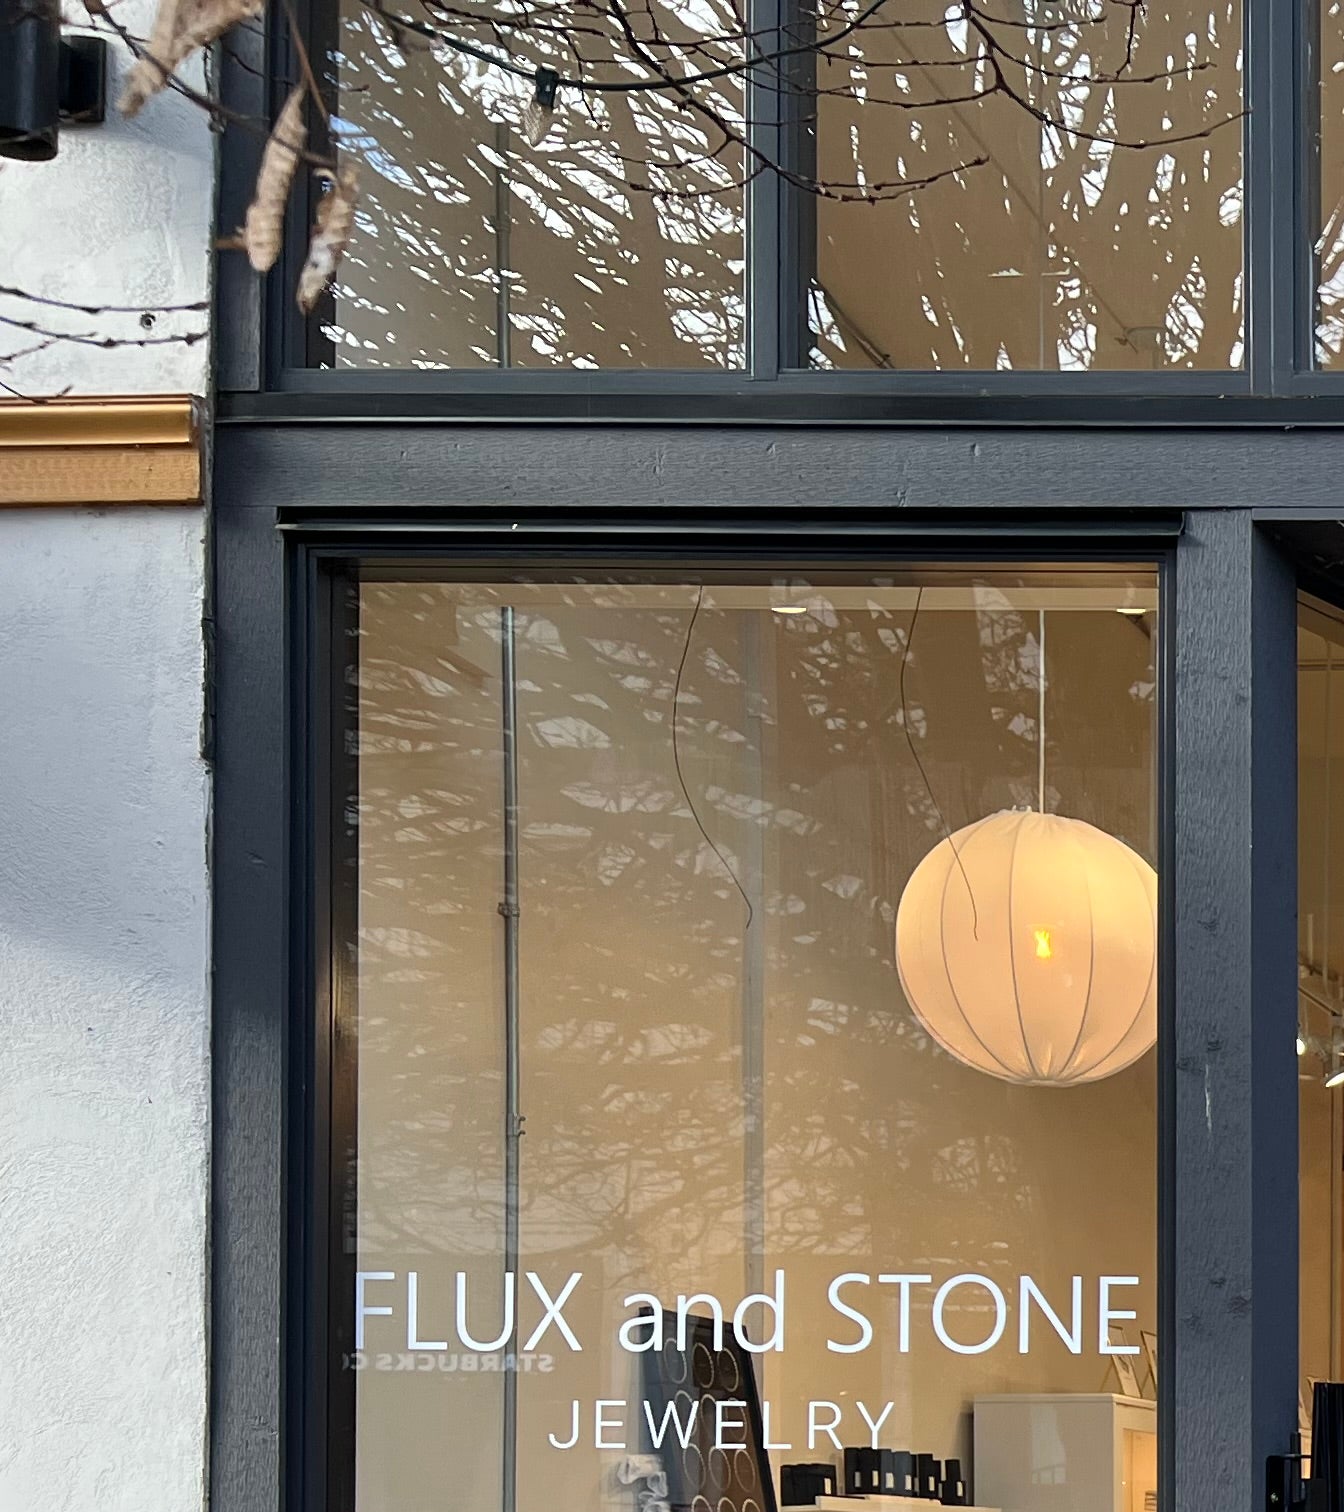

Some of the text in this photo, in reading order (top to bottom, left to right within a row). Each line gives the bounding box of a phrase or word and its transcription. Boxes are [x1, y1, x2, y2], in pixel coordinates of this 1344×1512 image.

[355, 1269, 1140, 1355] FLUX and STONE
[549, 1400, 894, 1450] JEWELRY
